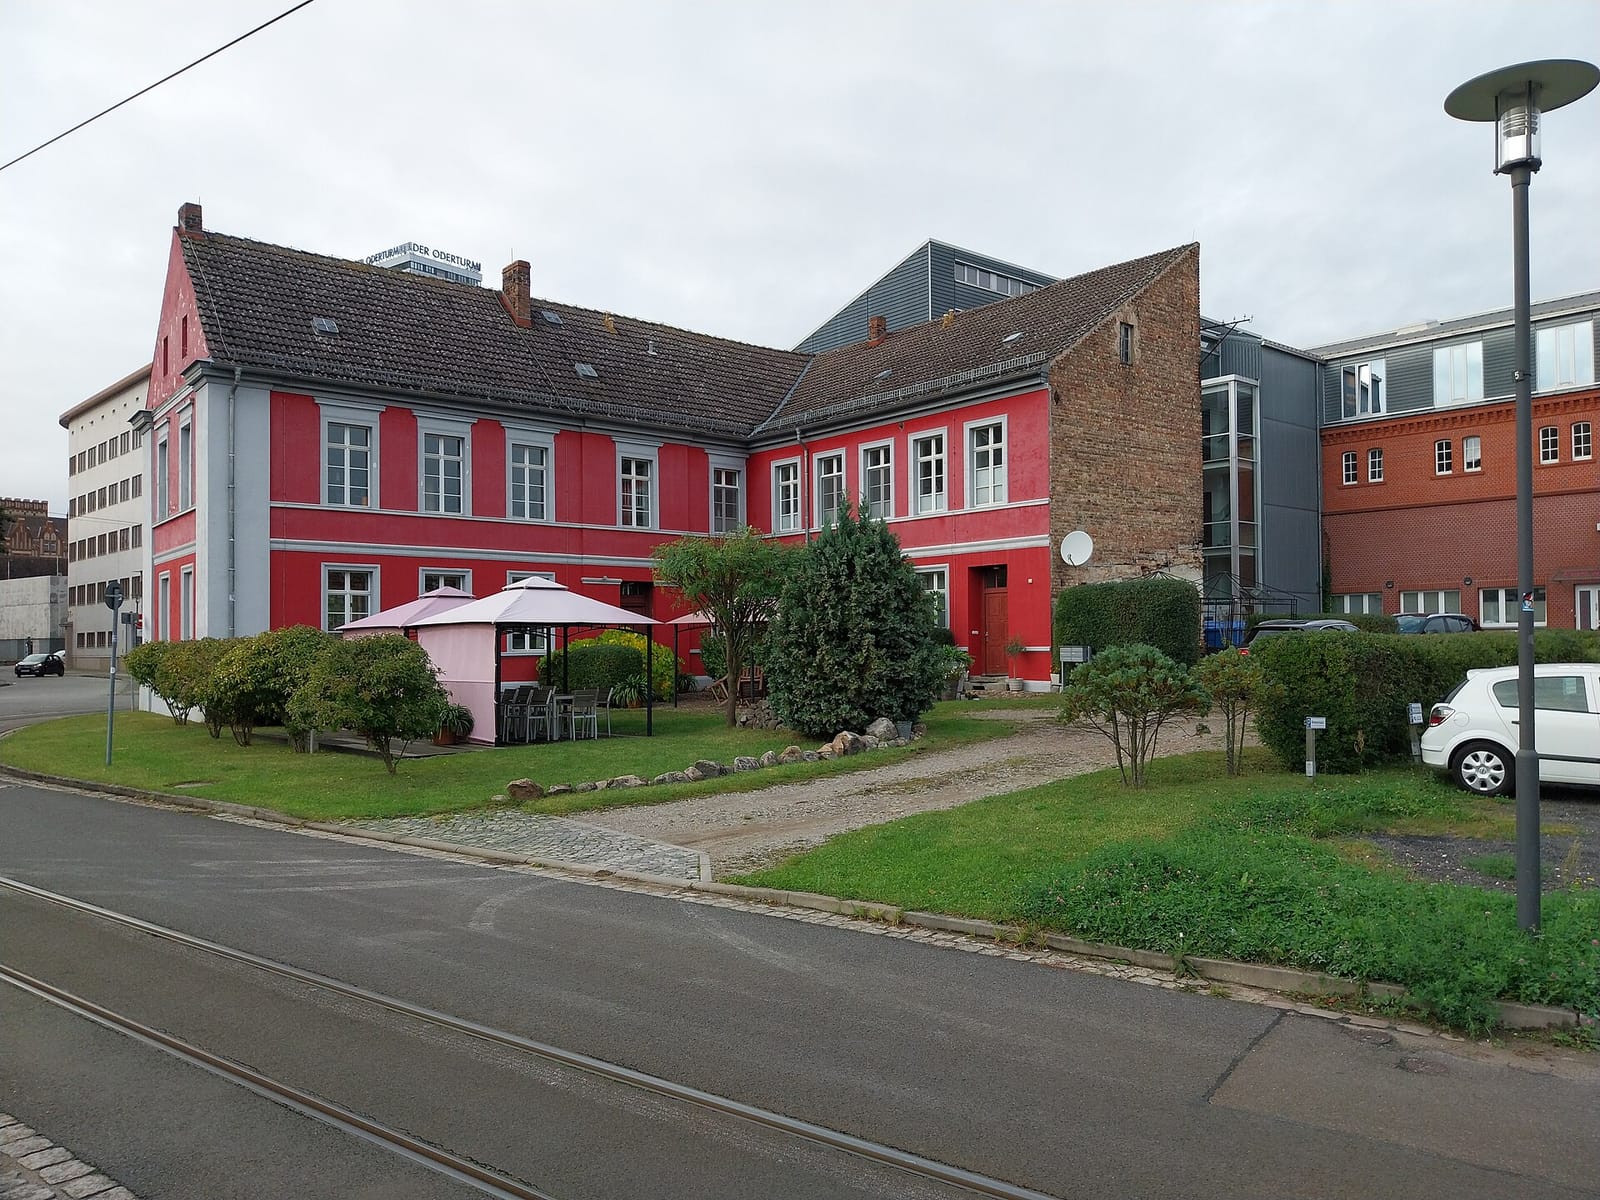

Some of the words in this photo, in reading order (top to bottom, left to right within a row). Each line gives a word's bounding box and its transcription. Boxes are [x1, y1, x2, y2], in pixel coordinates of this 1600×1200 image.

[412, 243, 429, 256] DER
[432, 249, 481, 271] ODERTURM
[1514, 371, 1520, 380] 5
